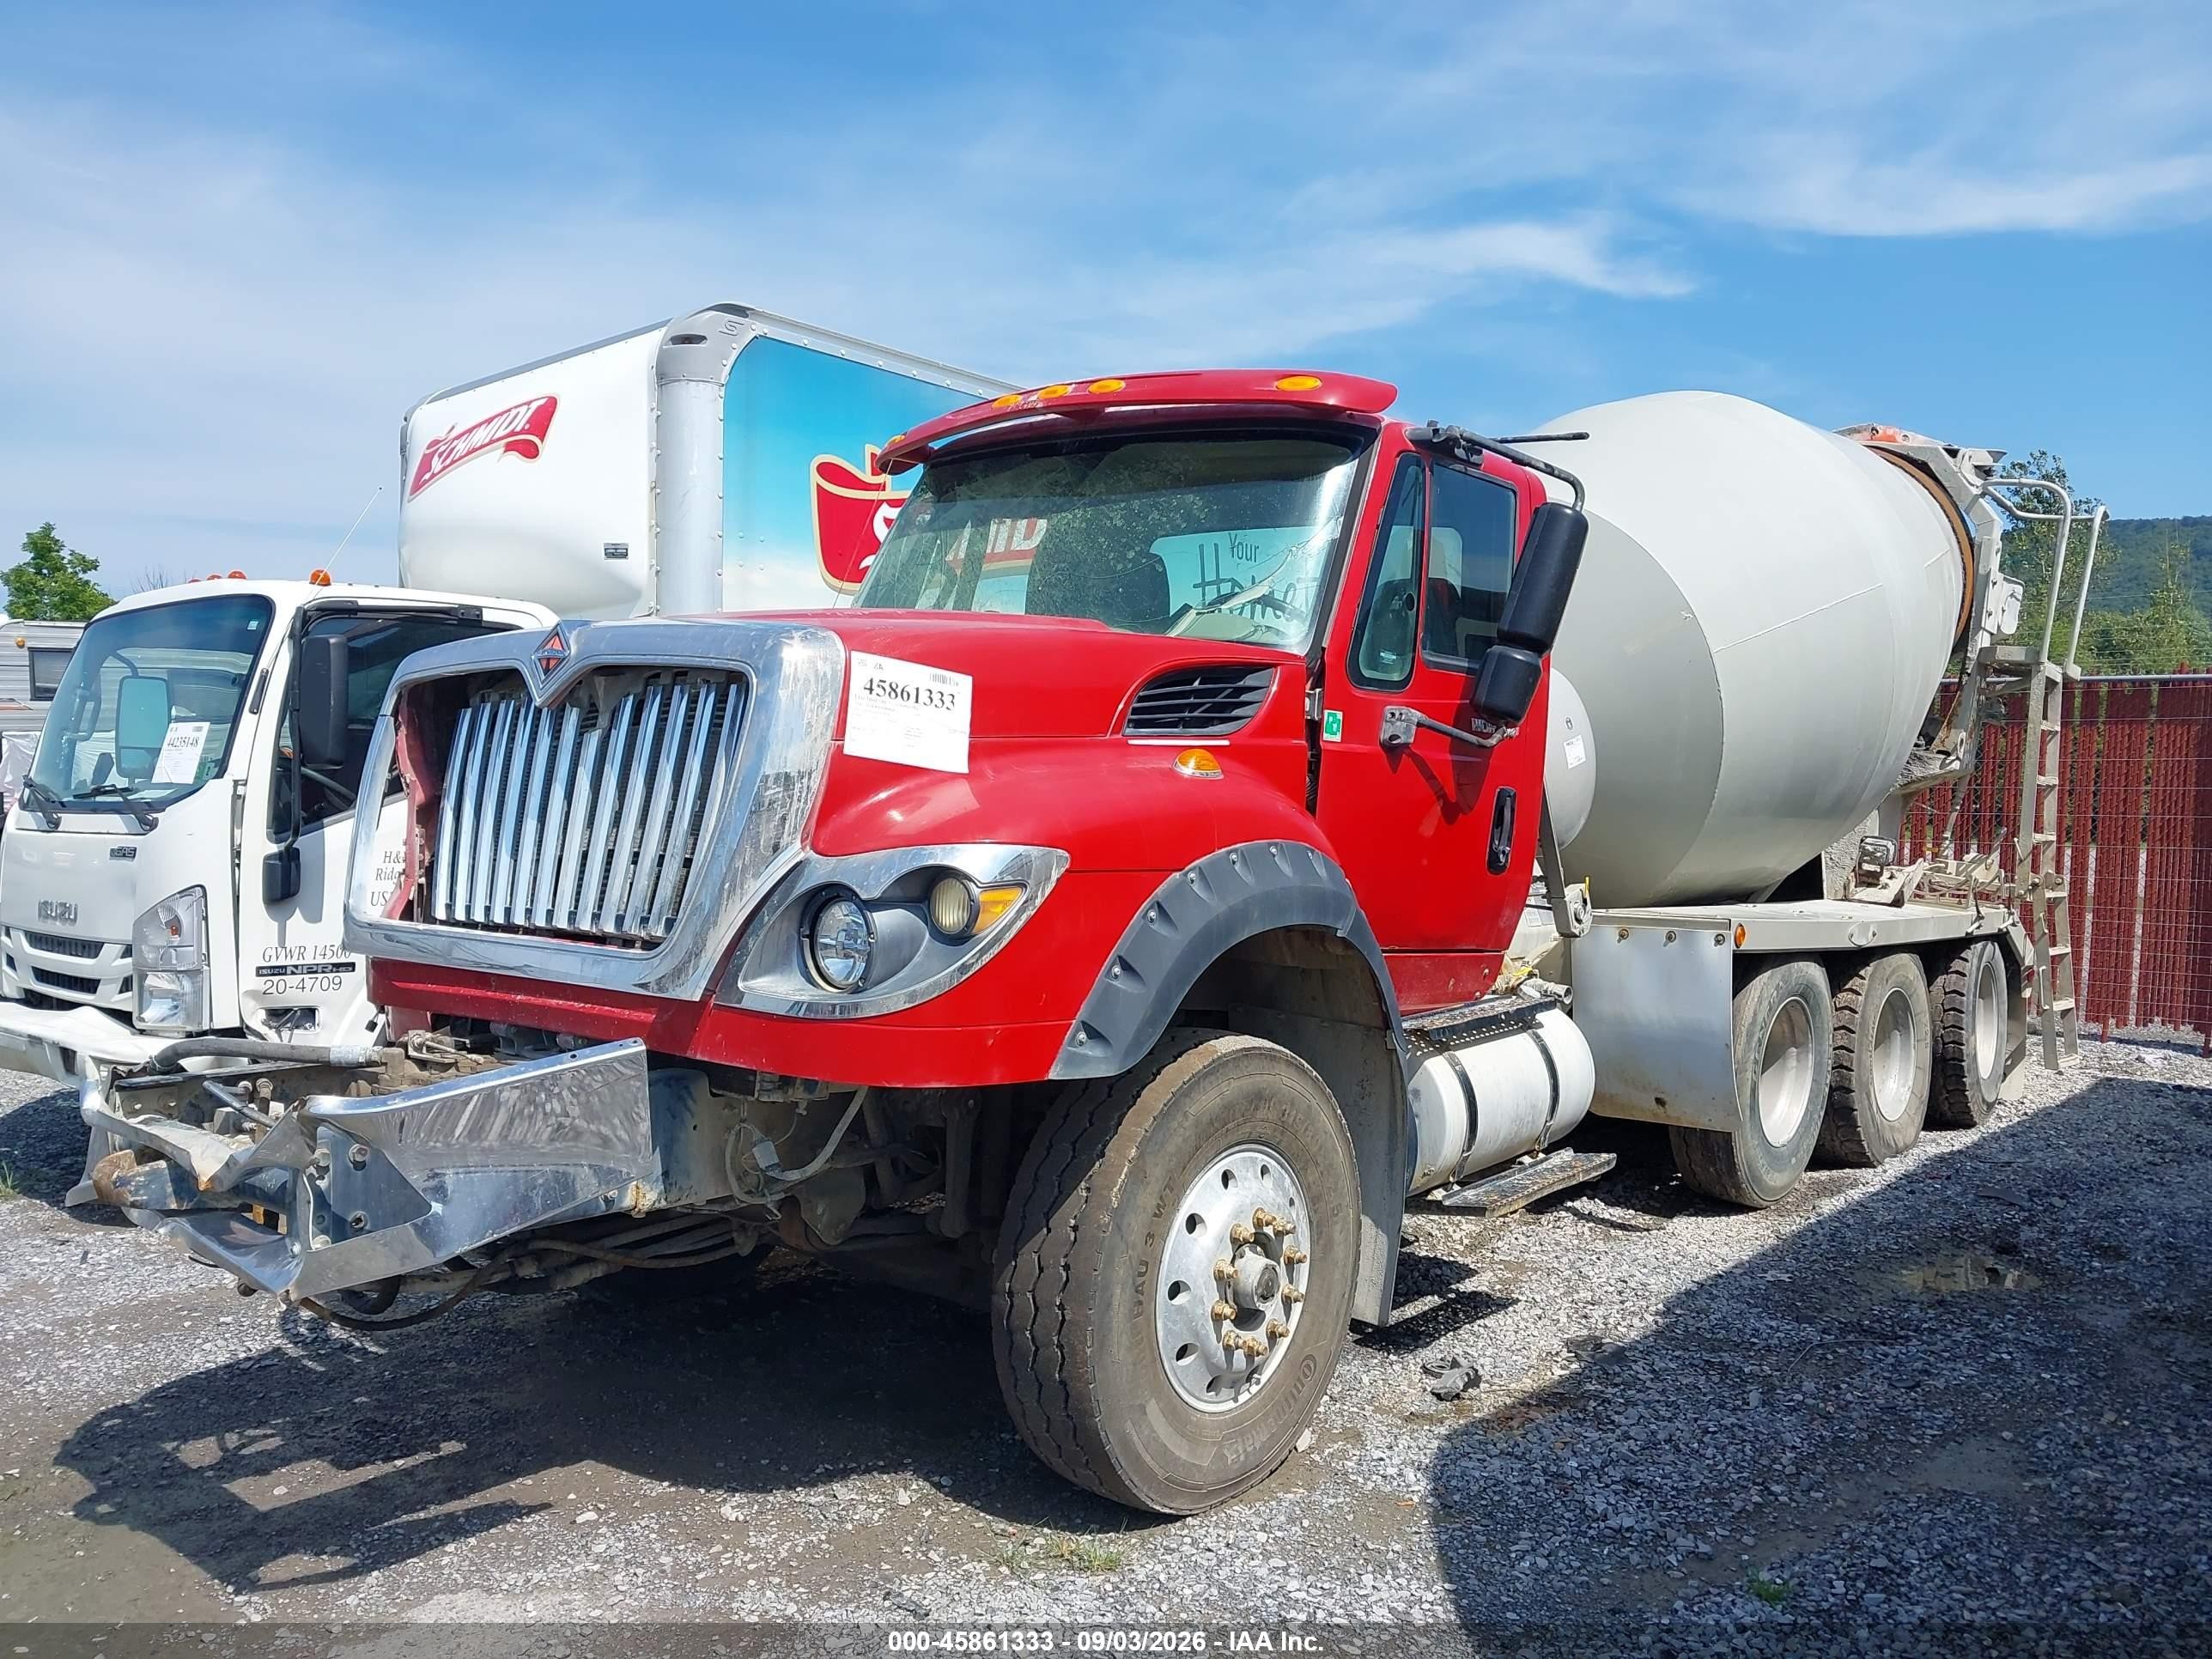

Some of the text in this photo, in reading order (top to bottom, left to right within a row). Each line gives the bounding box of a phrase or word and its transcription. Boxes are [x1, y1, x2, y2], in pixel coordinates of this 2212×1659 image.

[419, 398, 550, 485] SCHMIDT
[1228, 532, 1260, 563] Your
[863, 677, 956, 711] 45861333
[38, 900, 78, 926] ISUZU
[262, 945, 307, 963] GVWR
[262, 975, 343, 995] 20-4709
